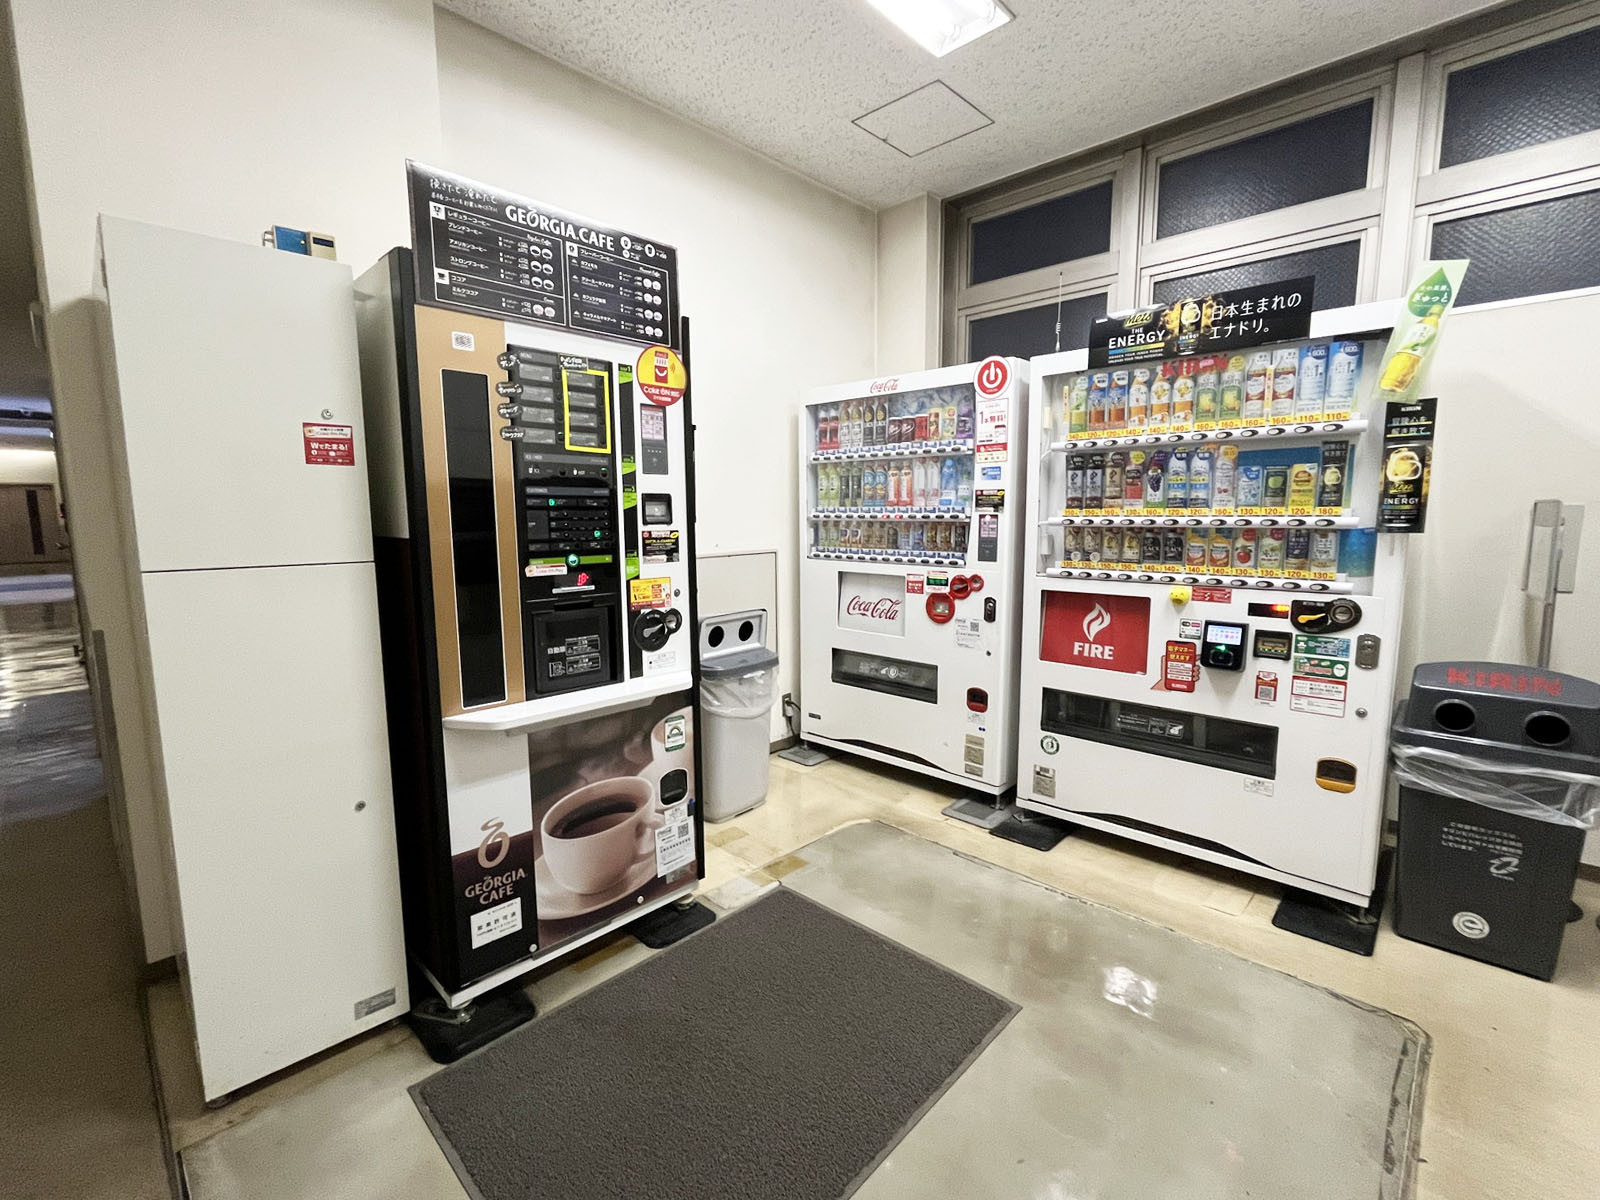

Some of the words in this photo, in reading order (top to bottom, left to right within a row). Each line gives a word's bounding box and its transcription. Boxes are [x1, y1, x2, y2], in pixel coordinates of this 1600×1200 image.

[451, 275, 467, 283] ココア
[1211, 292, 1302, 321] 日本生まれの
[1108, 329, 1166, 349] ENERGY
[1209, 318, 1270, 340] エナドリ。
[1384, 497, 1419, 505] ENERGY
[1072, 641, 1115, 660] FIRE
[1447, 666, 1562, 696] KIRIN
[480, 883, 514, 905] CAFE
